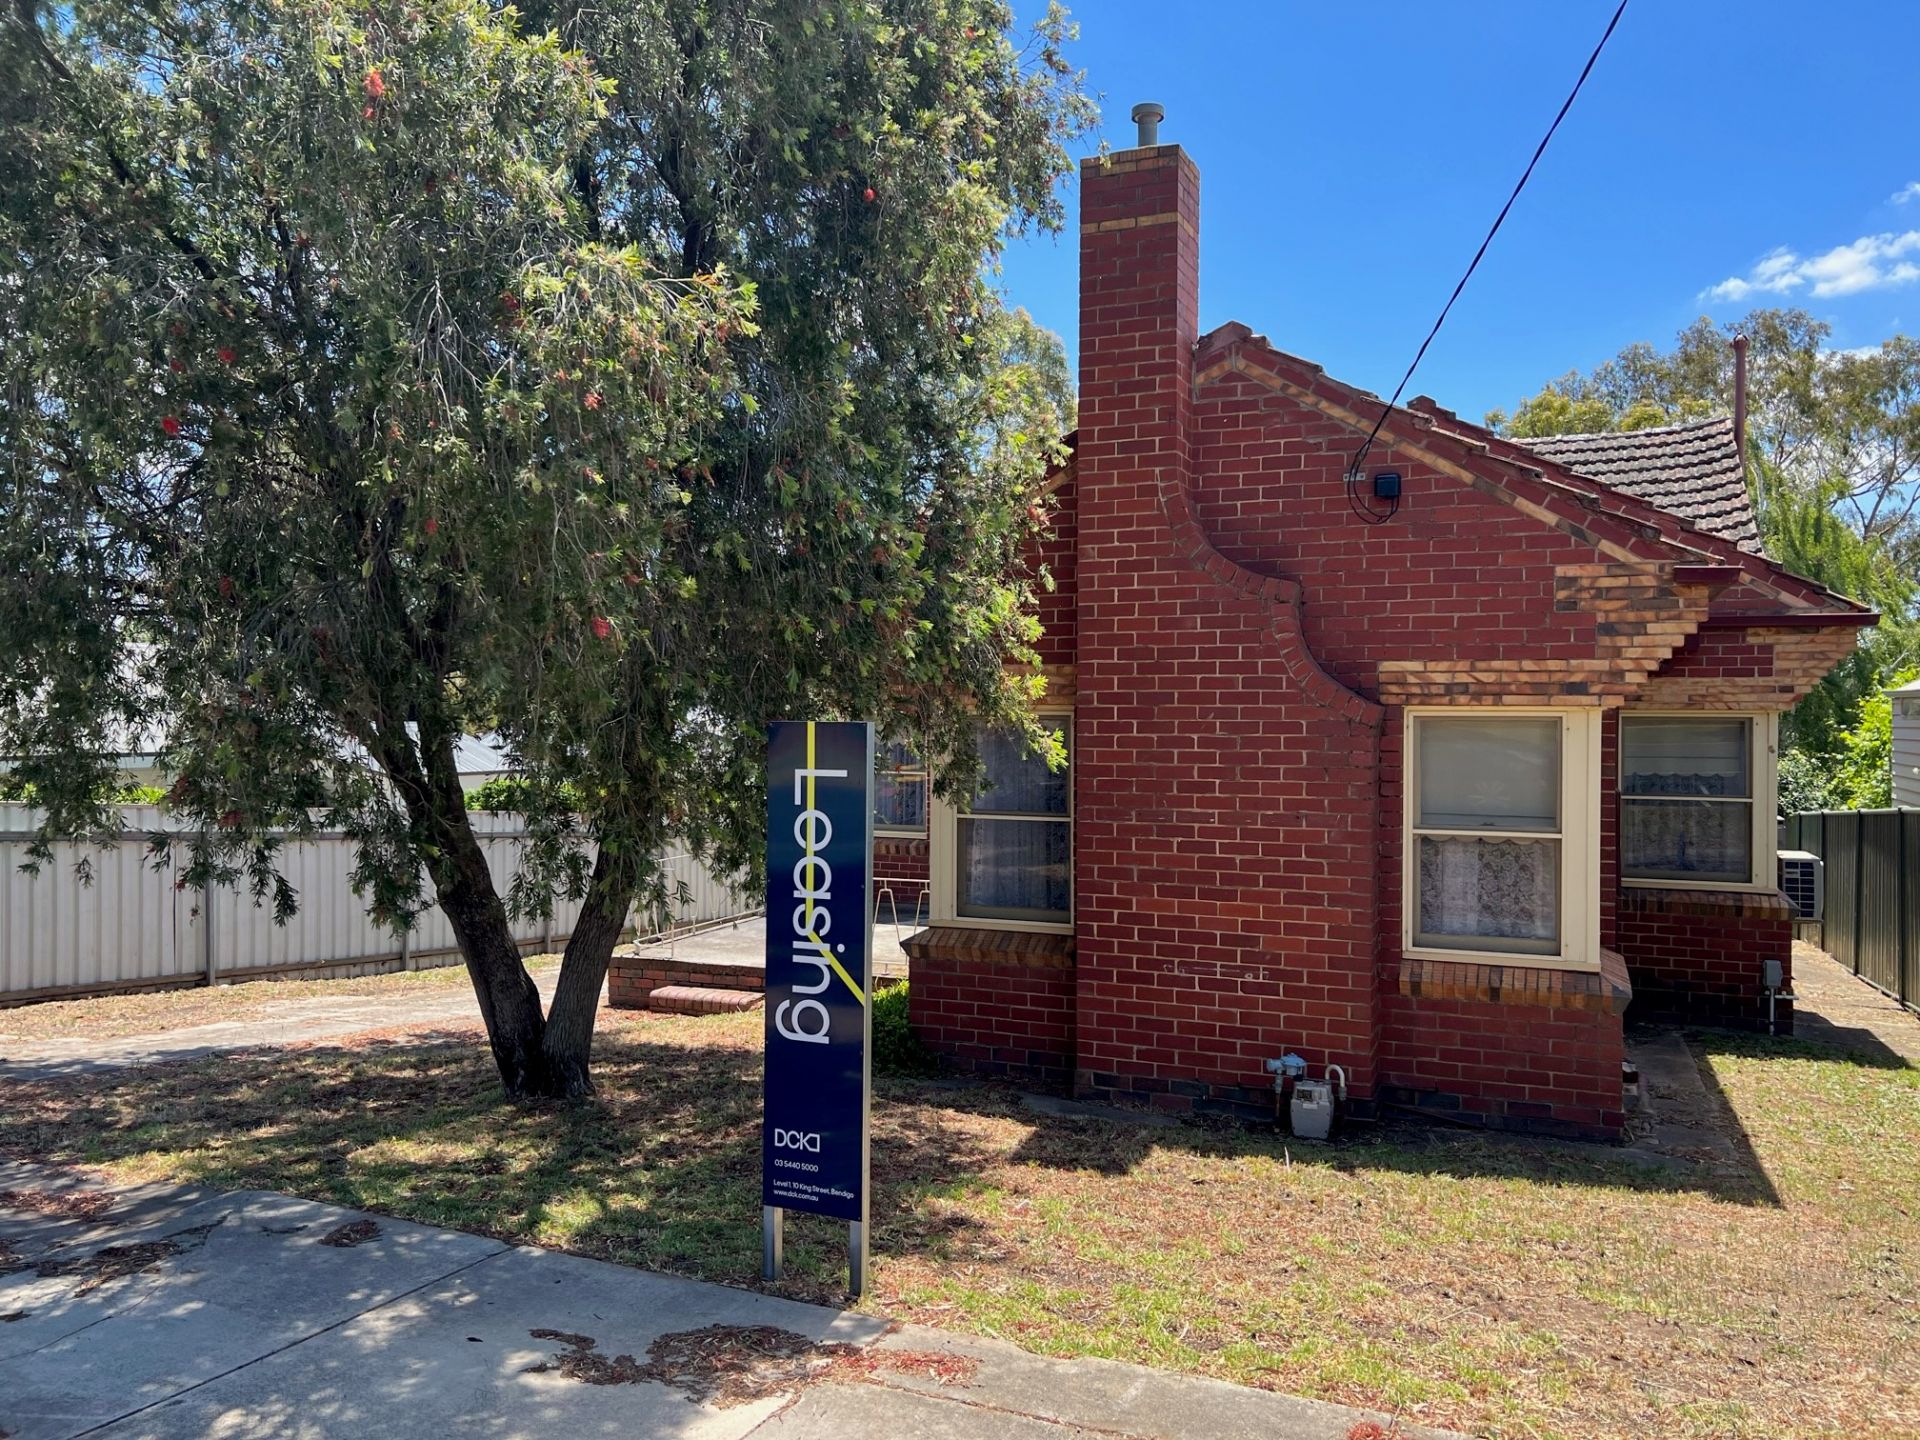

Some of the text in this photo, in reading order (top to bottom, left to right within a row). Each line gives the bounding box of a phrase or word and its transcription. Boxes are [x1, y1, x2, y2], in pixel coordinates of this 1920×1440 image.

[774, 768, 848, 1044] Leasing
[774, 1158, 818, 1172] 03 5440 5000
[773, 1189, 818, 1201] www.dck.com.au
[792, 1181, 799, 1190] 10
[800, 1183, 812, 1192] King
[831, 1188, 854, 1199] Bendigo
